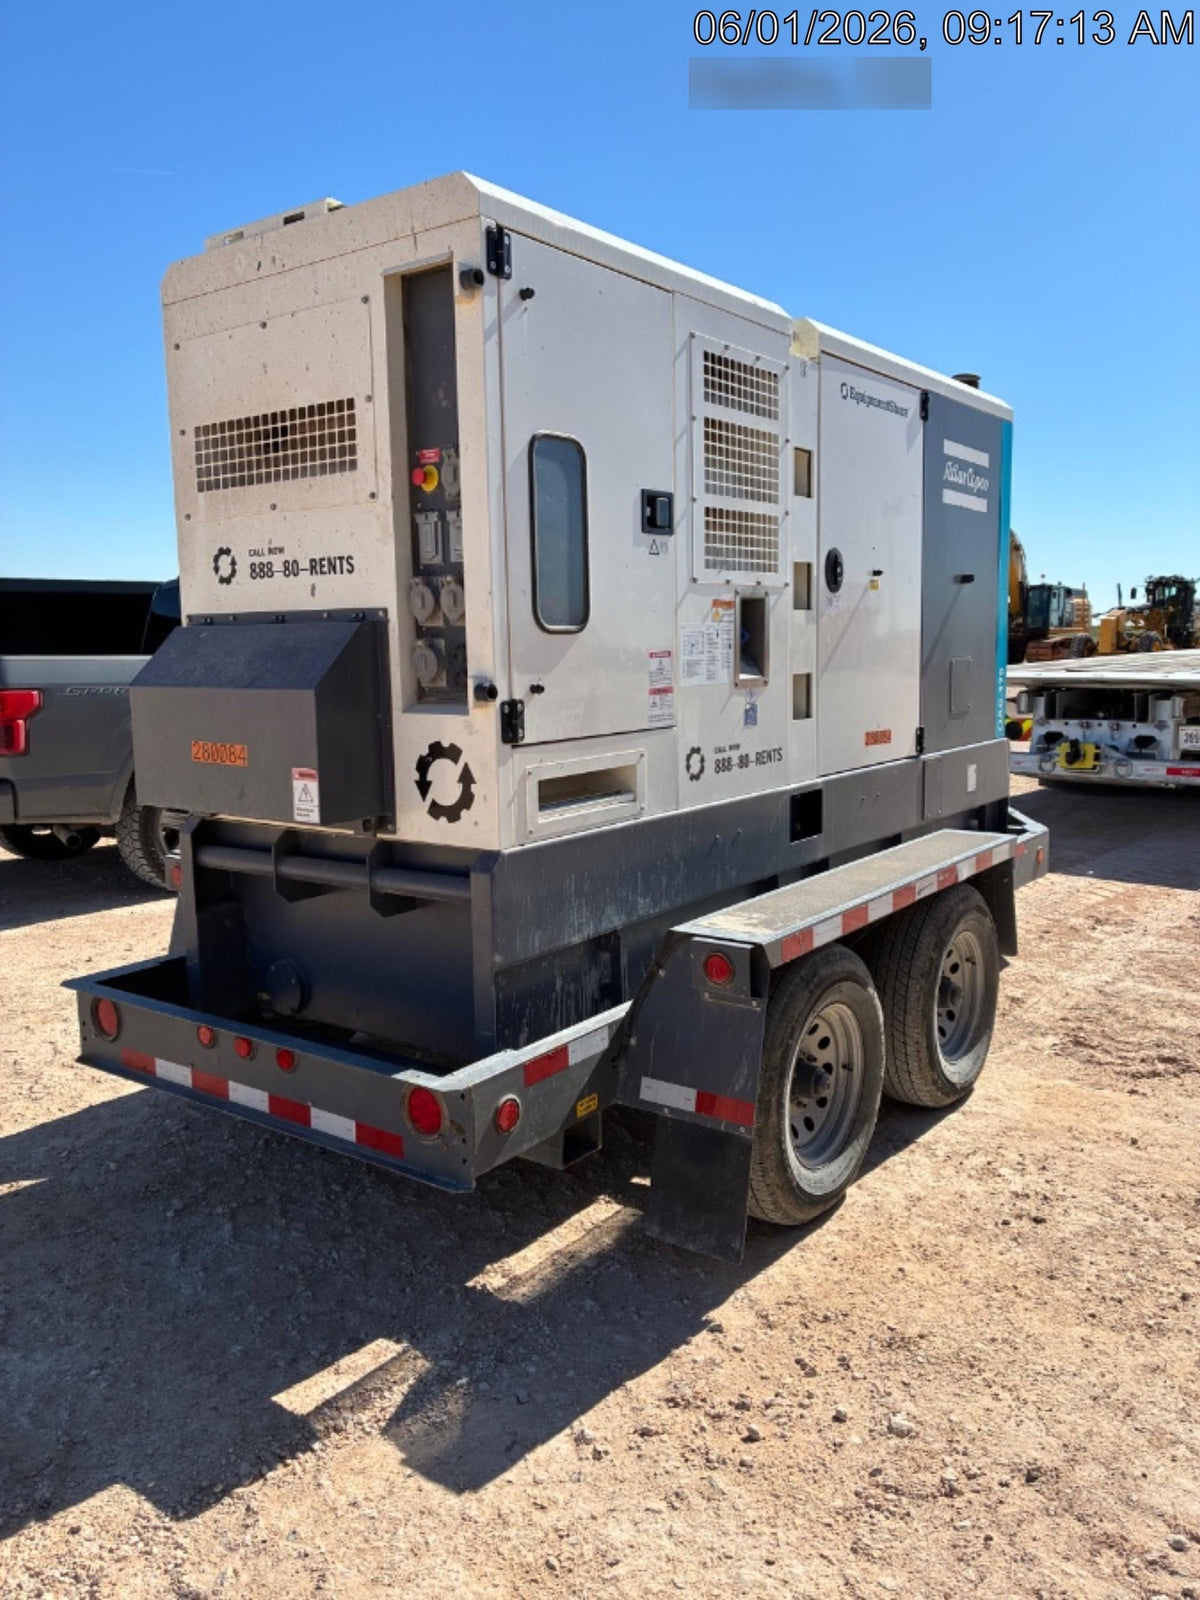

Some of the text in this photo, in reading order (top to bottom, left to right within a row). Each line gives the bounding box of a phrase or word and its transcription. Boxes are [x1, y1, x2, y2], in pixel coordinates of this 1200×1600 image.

[248, 546, 285, 557] CALL NOW
[249, 555, 355, 581] 888-80-RENTS
[714, 747, 783, 775] 888-80-RENTS
